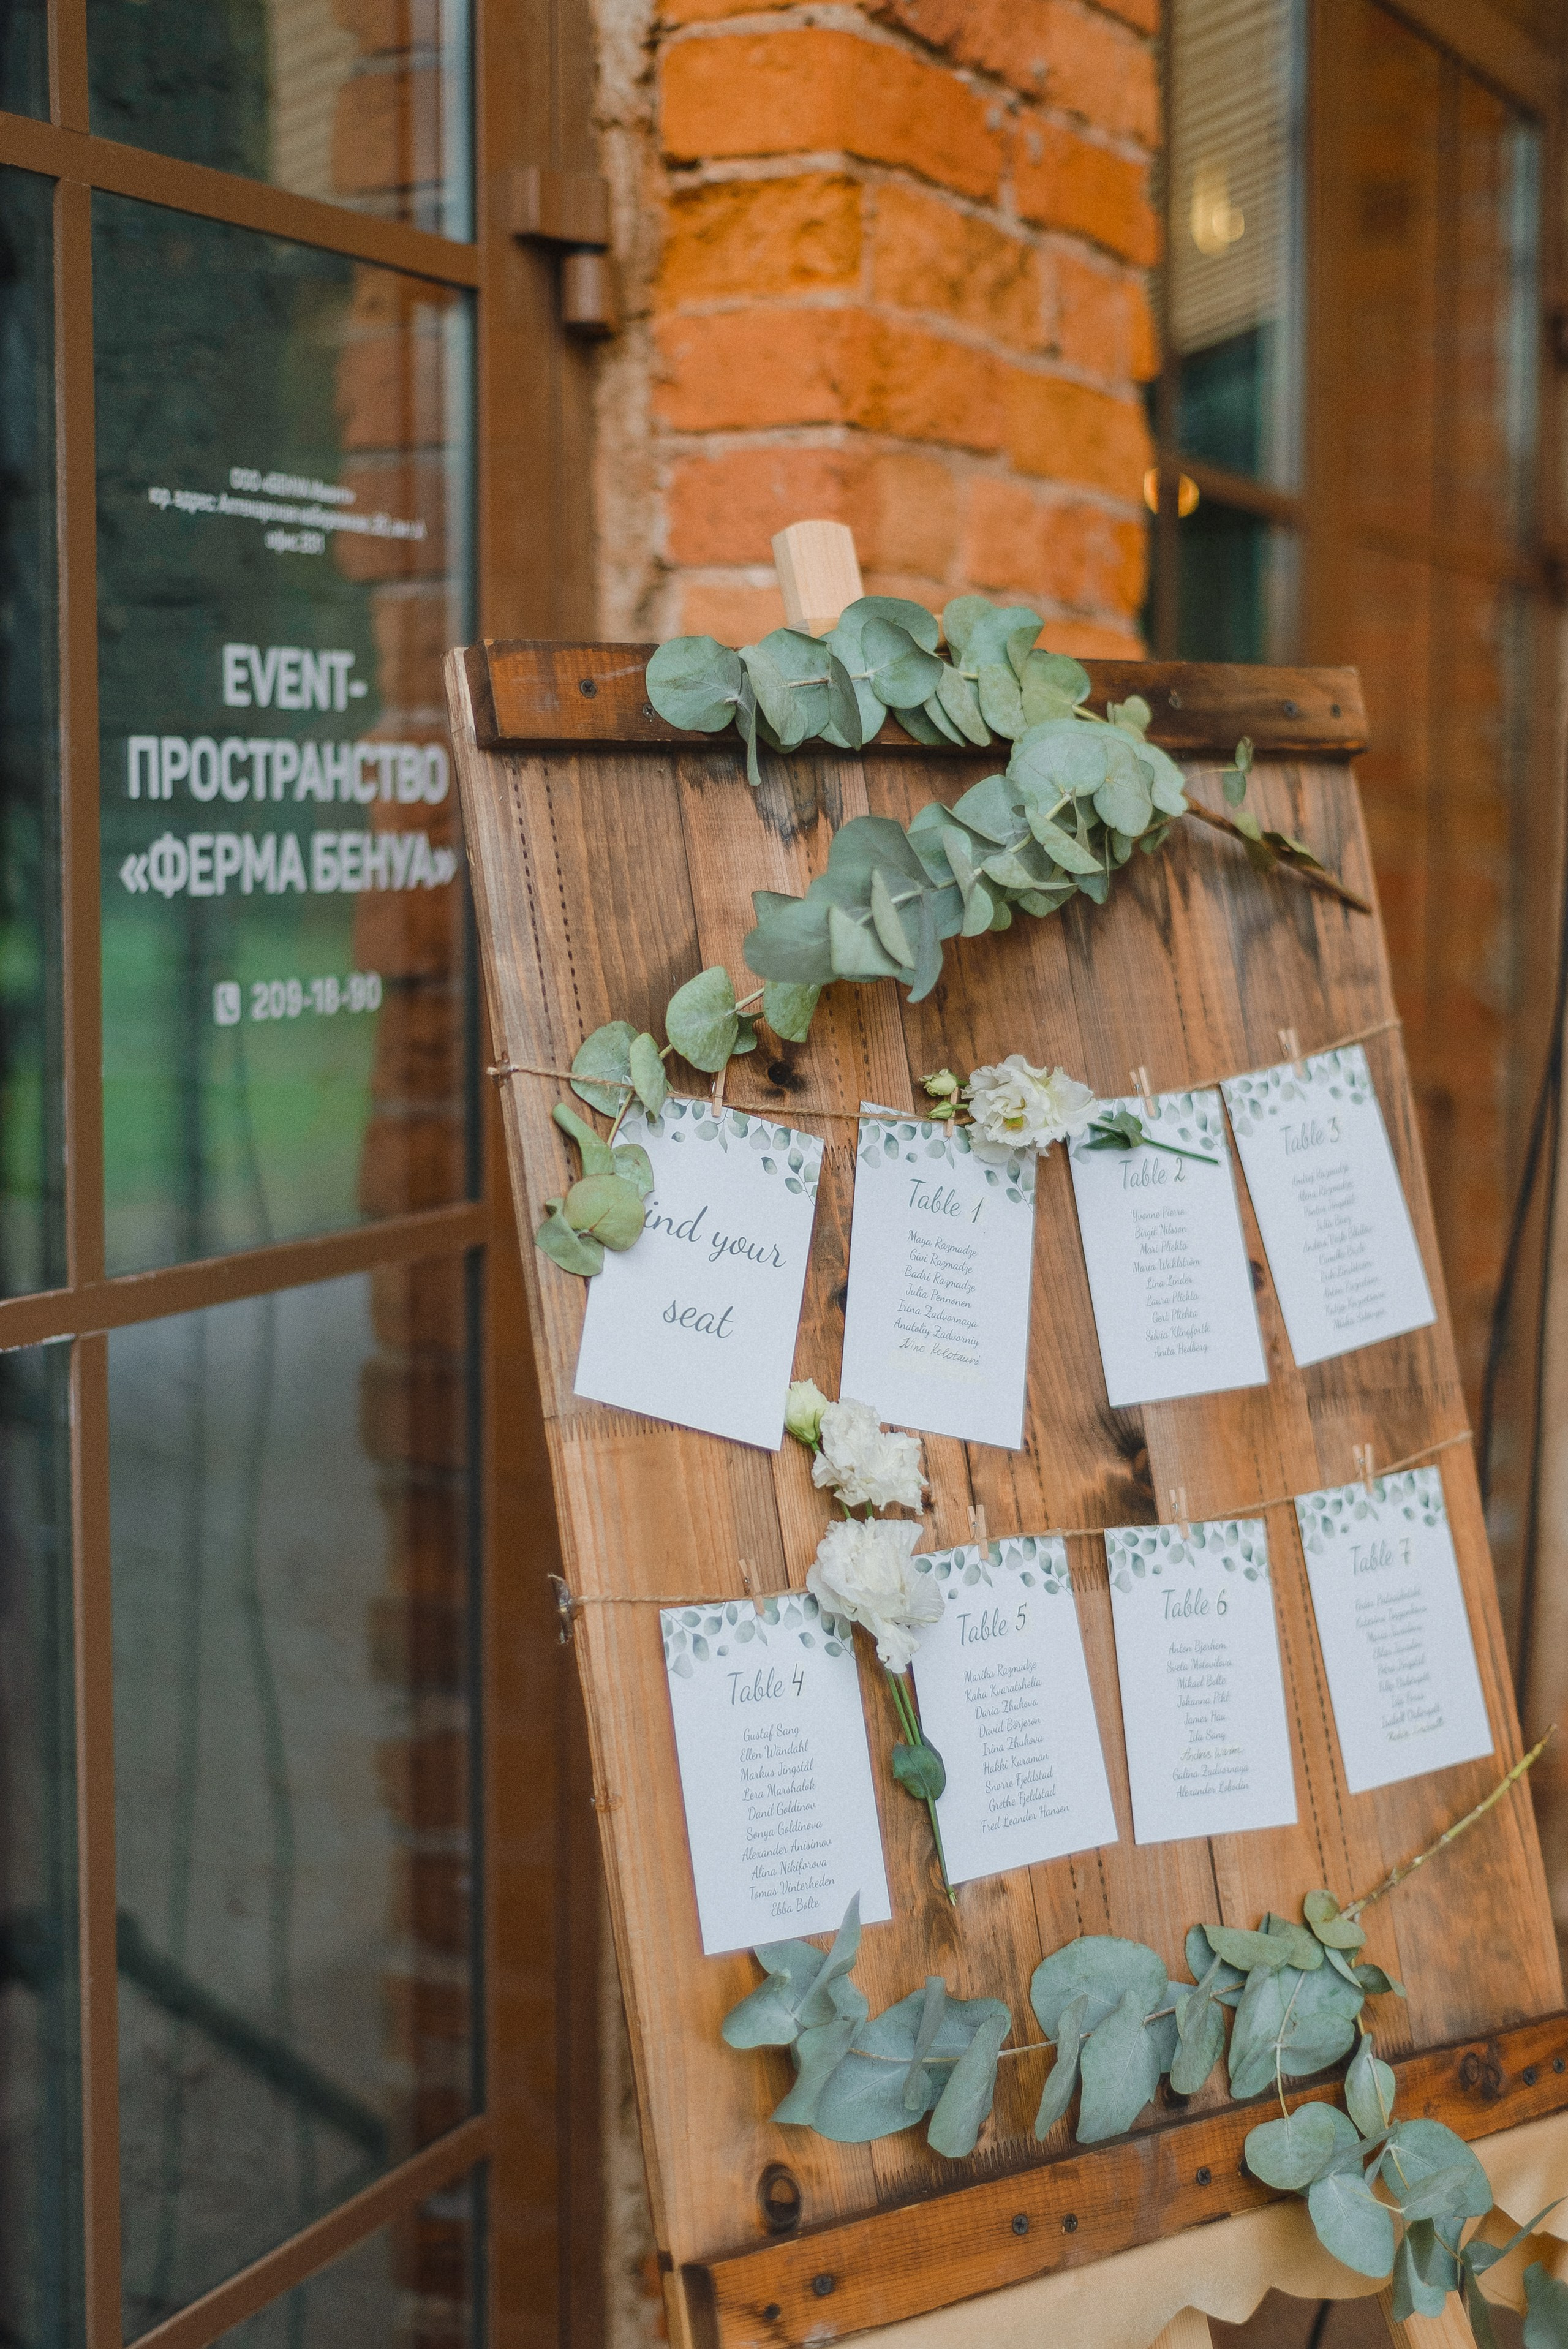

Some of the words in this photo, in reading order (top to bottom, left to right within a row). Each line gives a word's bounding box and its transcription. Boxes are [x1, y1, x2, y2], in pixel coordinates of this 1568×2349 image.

[222, 642, 368, 712] EVENT-
[127, 736, 449, 804] ПРОСТРАНСТВО
[121, 832, 307, 899] «ФЕРМА
[312, 830, 458, 894] БЕНУА»
[1279, 1119, 1325, 1156] Table
[1118, 1157, 1167, 1190] Table
[1174, 1157, 1185, 1182] 2
[909, 1178, 961, 1217] Table
[971, 1197, 984, 1223] 1
[1131, 1209, 1161, 1223] Yvonne
[1163, 1206, 1185, 1218] Pierre
[643, 1201, 709, 1242] ind
[709, 1231, 787, 1268] your
[907, 1229, 932, 1248] Maya
[935, 1236, 978, 1259] Razmadze
[1135, 1226, 1158, 1240] Birgit
[1160, 1223, 1187, 1235] Nilsson
[1140, 1243, 1159, 1255] Mari
[1161, 1240, 1188, 1253] Plichta
[910, 1248, 928, 1263] Givi
[930, 1253, 973, 1276] Razmadze
[1132, 1262, 1156, 1273] Maria
[904, 1264, 931, 1281] Badri
[933, 1272, 976, 1294] Razmadze
[1146, 1277, 1165, 1289] Lina
[1167, 1275, 1193, 1286] Linder
[905, 1283, 928, 1299] Julia
[930, 1289, 971, 1308] Pennonen
[1146, 1295, 1170, 1307] Laura
[1172, 1290, 1199, 1303] Plichta
[663, 1300, 734, 1338] seat
[897, 1299, 921, 1315] Irina
[924, 1305, 978, 1330] Zadvornaya
[1152, 1311, 1169, 1324] Gert
[1172, 1308, 1198, 1321] Plichta
[893, 1317, 931, 1338] Anatoliy
[932, 1325, 979, 1349] Zadvorniy
[1145, 1329, 1169, 1342] Silvia
[1154, 1346, 1175, 1359] Anita
[1348, 1540, 1393, 1575] Table
[1399, 1537, 1409, 1566] 7
[1161, 1586, 1210, 1619] Table
[1216, 1588, 1227, 1615] 6
[956, 1607, 1009, 1646] Table
[1015, 1602, 1027, 1631] 5
[964, 1667, 995, 1684] Marika
[997, 1657, 1037, 1678] Razmadze
[727, 1667, 785, 1706] Table
[792, 1663, 804, 1697] 4
[965, 1687, 988, 1703] Kaha
[990, 1675, 1042, 1698] Kvaratshelia
[975, 1706, 1000, 1720] Daria
[1001, 1697, 1039, 1713] Zhukova
[743, 1725, 773, 1743] Gustaf
[776, 1723, 799, 1738] Sang
[978, 1720, 1004, 1738] David
[739, 1748, 763, 1763] Ellen
[764, 1738, 809, 1759] Wändahl
[982, 1742, 1005, 1757] Irina
[1007, 1733, 1043, 1751] Zhukova
[740, 1765, 775, 1782] Markus
[777, 1757, 814, 1777] Jingstål
[983, 1758, 1009, 1775] Hakki
[1011, 1754, 1049, 1768] Karaman
[985, 1780, 1013, 1794] Snorre
[1016, 1765, 1054, 1789] Fjeldstad
[742, 1787, 765, 1801] Lera
[989, 1795, 1016, 1812] Grethe
[1018, 1783, 1056, 1807] Fjeldstad
[747, 1803, 774, 1821] Danil
[776, 1800, 816, 1816] Goldinov
[981, 1816, 1001, 1833] Fred
[1002, 1809, 1037, 1828] Leander
[1039, 1805, 1070, 1819] Hansen
[746, 1827, 775, 1841] Sonya
[777, 1819, 823, 1836] Goldinova
[742, 1842, 788, 1862] Alexander
[790, 1839, 832, 1853] Anisimov
[752, 1865, 777, 1880] Alina
[779, 1858, 827, 1875] Nikiforova
[749, 1886, 777, 1901] Tomas
[780, 1873, 835, 1895] Vinterheden
[771, 1901, 793, 1917] Ebba
[796, 1896, 820, 1912] Bolte
